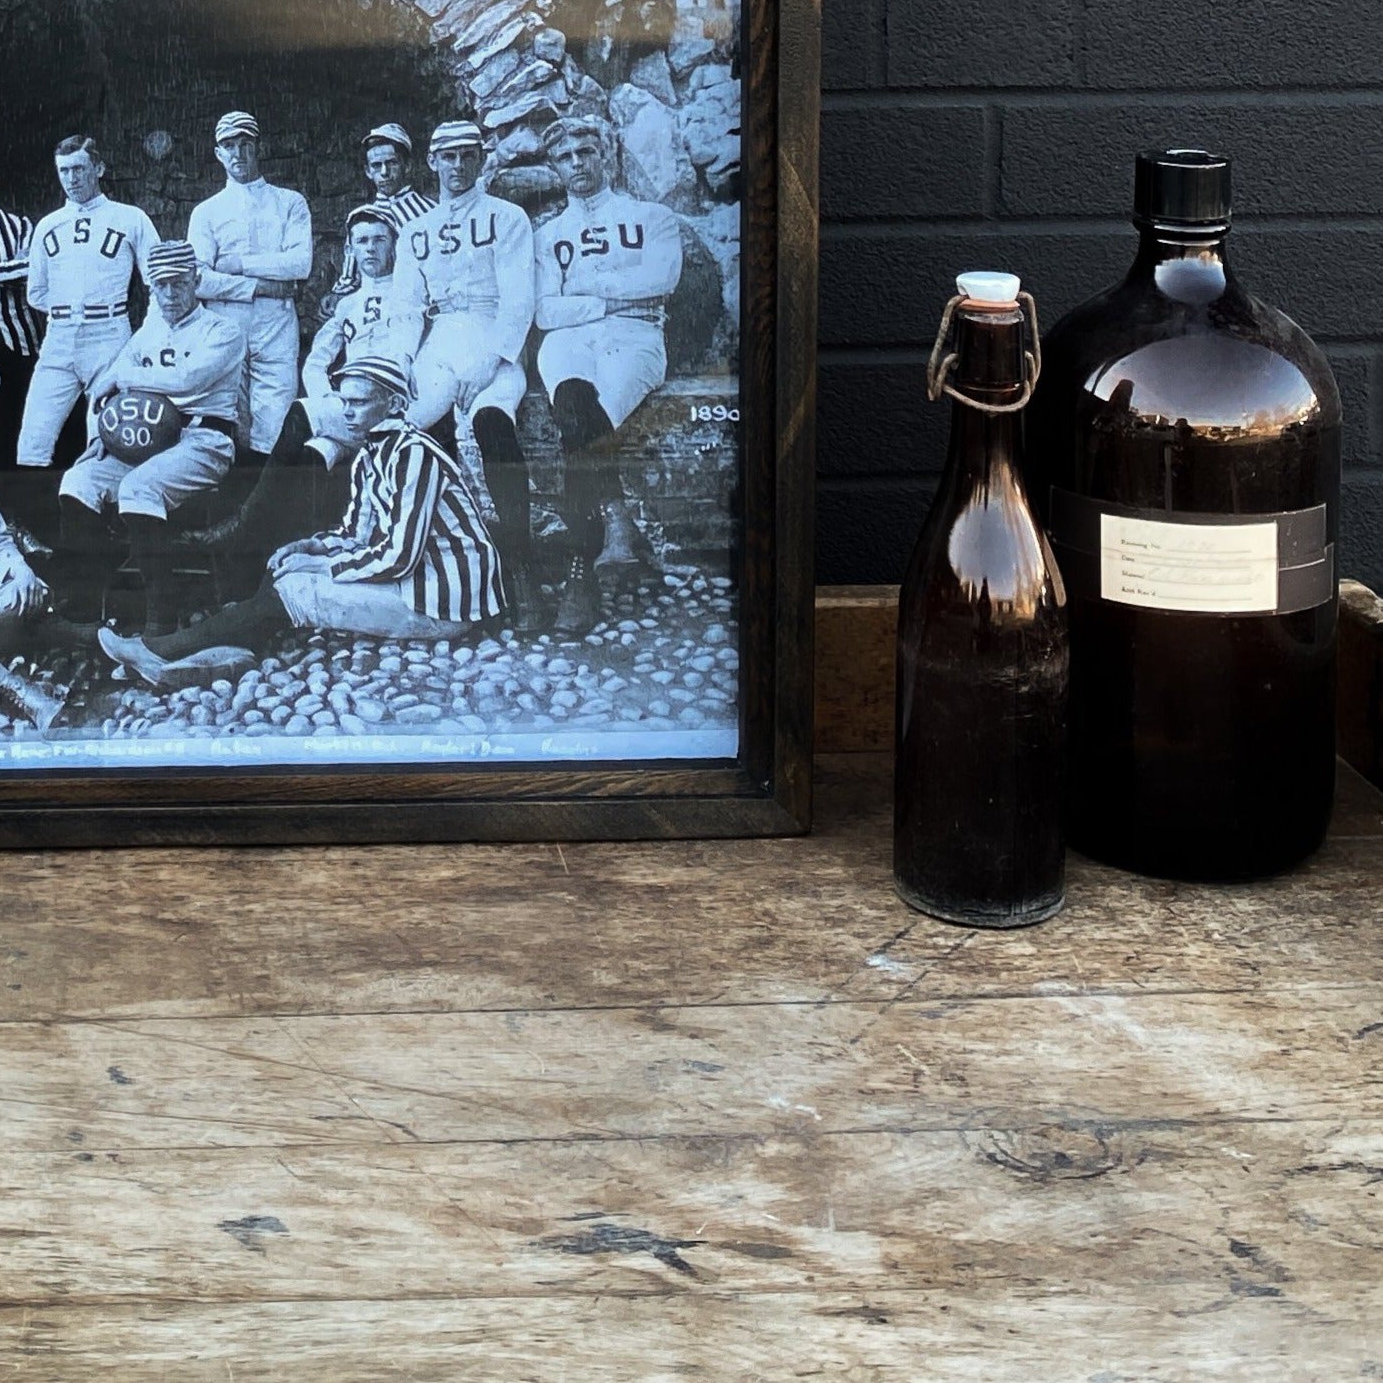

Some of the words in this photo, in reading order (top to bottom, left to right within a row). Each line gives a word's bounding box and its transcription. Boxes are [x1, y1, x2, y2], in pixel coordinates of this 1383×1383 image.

[43, 217, 127, 259] OSU
[411, 213, 496, 260] OSU
[554, 223, 645, 271] OSU
[102, 398, 165, 432] OSU
[121, 426, 151, 447] 90
